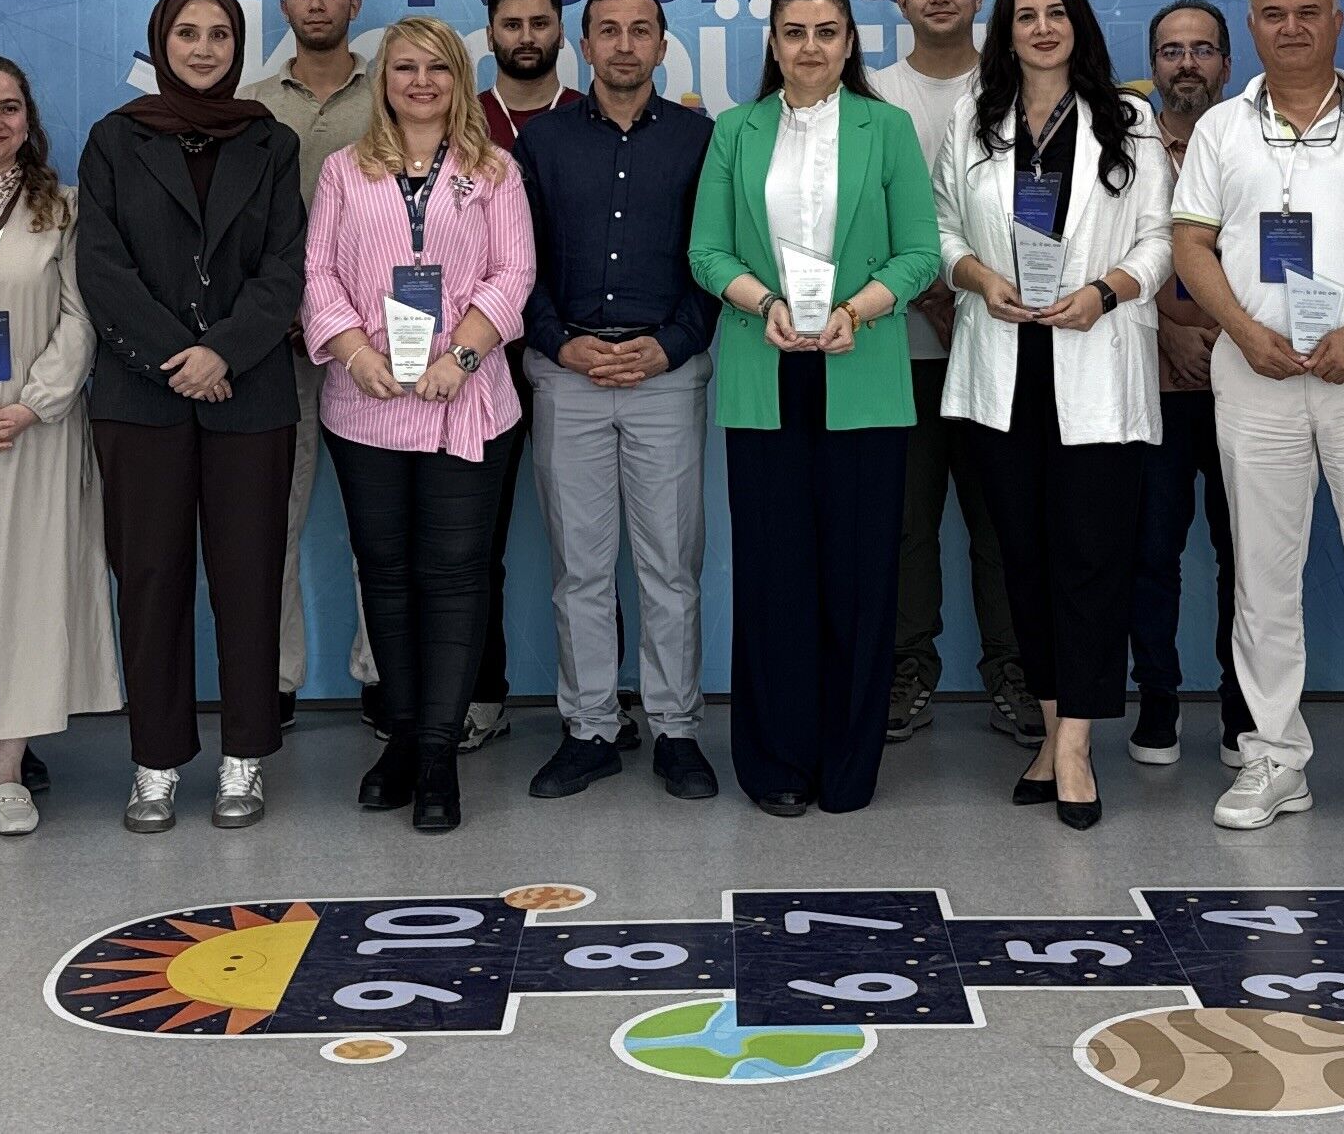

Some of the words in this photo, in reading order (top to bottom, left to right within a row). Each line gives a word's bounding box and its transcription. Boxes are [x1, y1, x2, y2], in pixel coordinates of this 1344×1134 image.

[357, 907, 484, 954] 10
[785, 910, 904, 934] 7
[1202, 905, 1319, 934] 4
[564, 942, 689, 970] 8
[1005, 938, 1133, 968] 5
